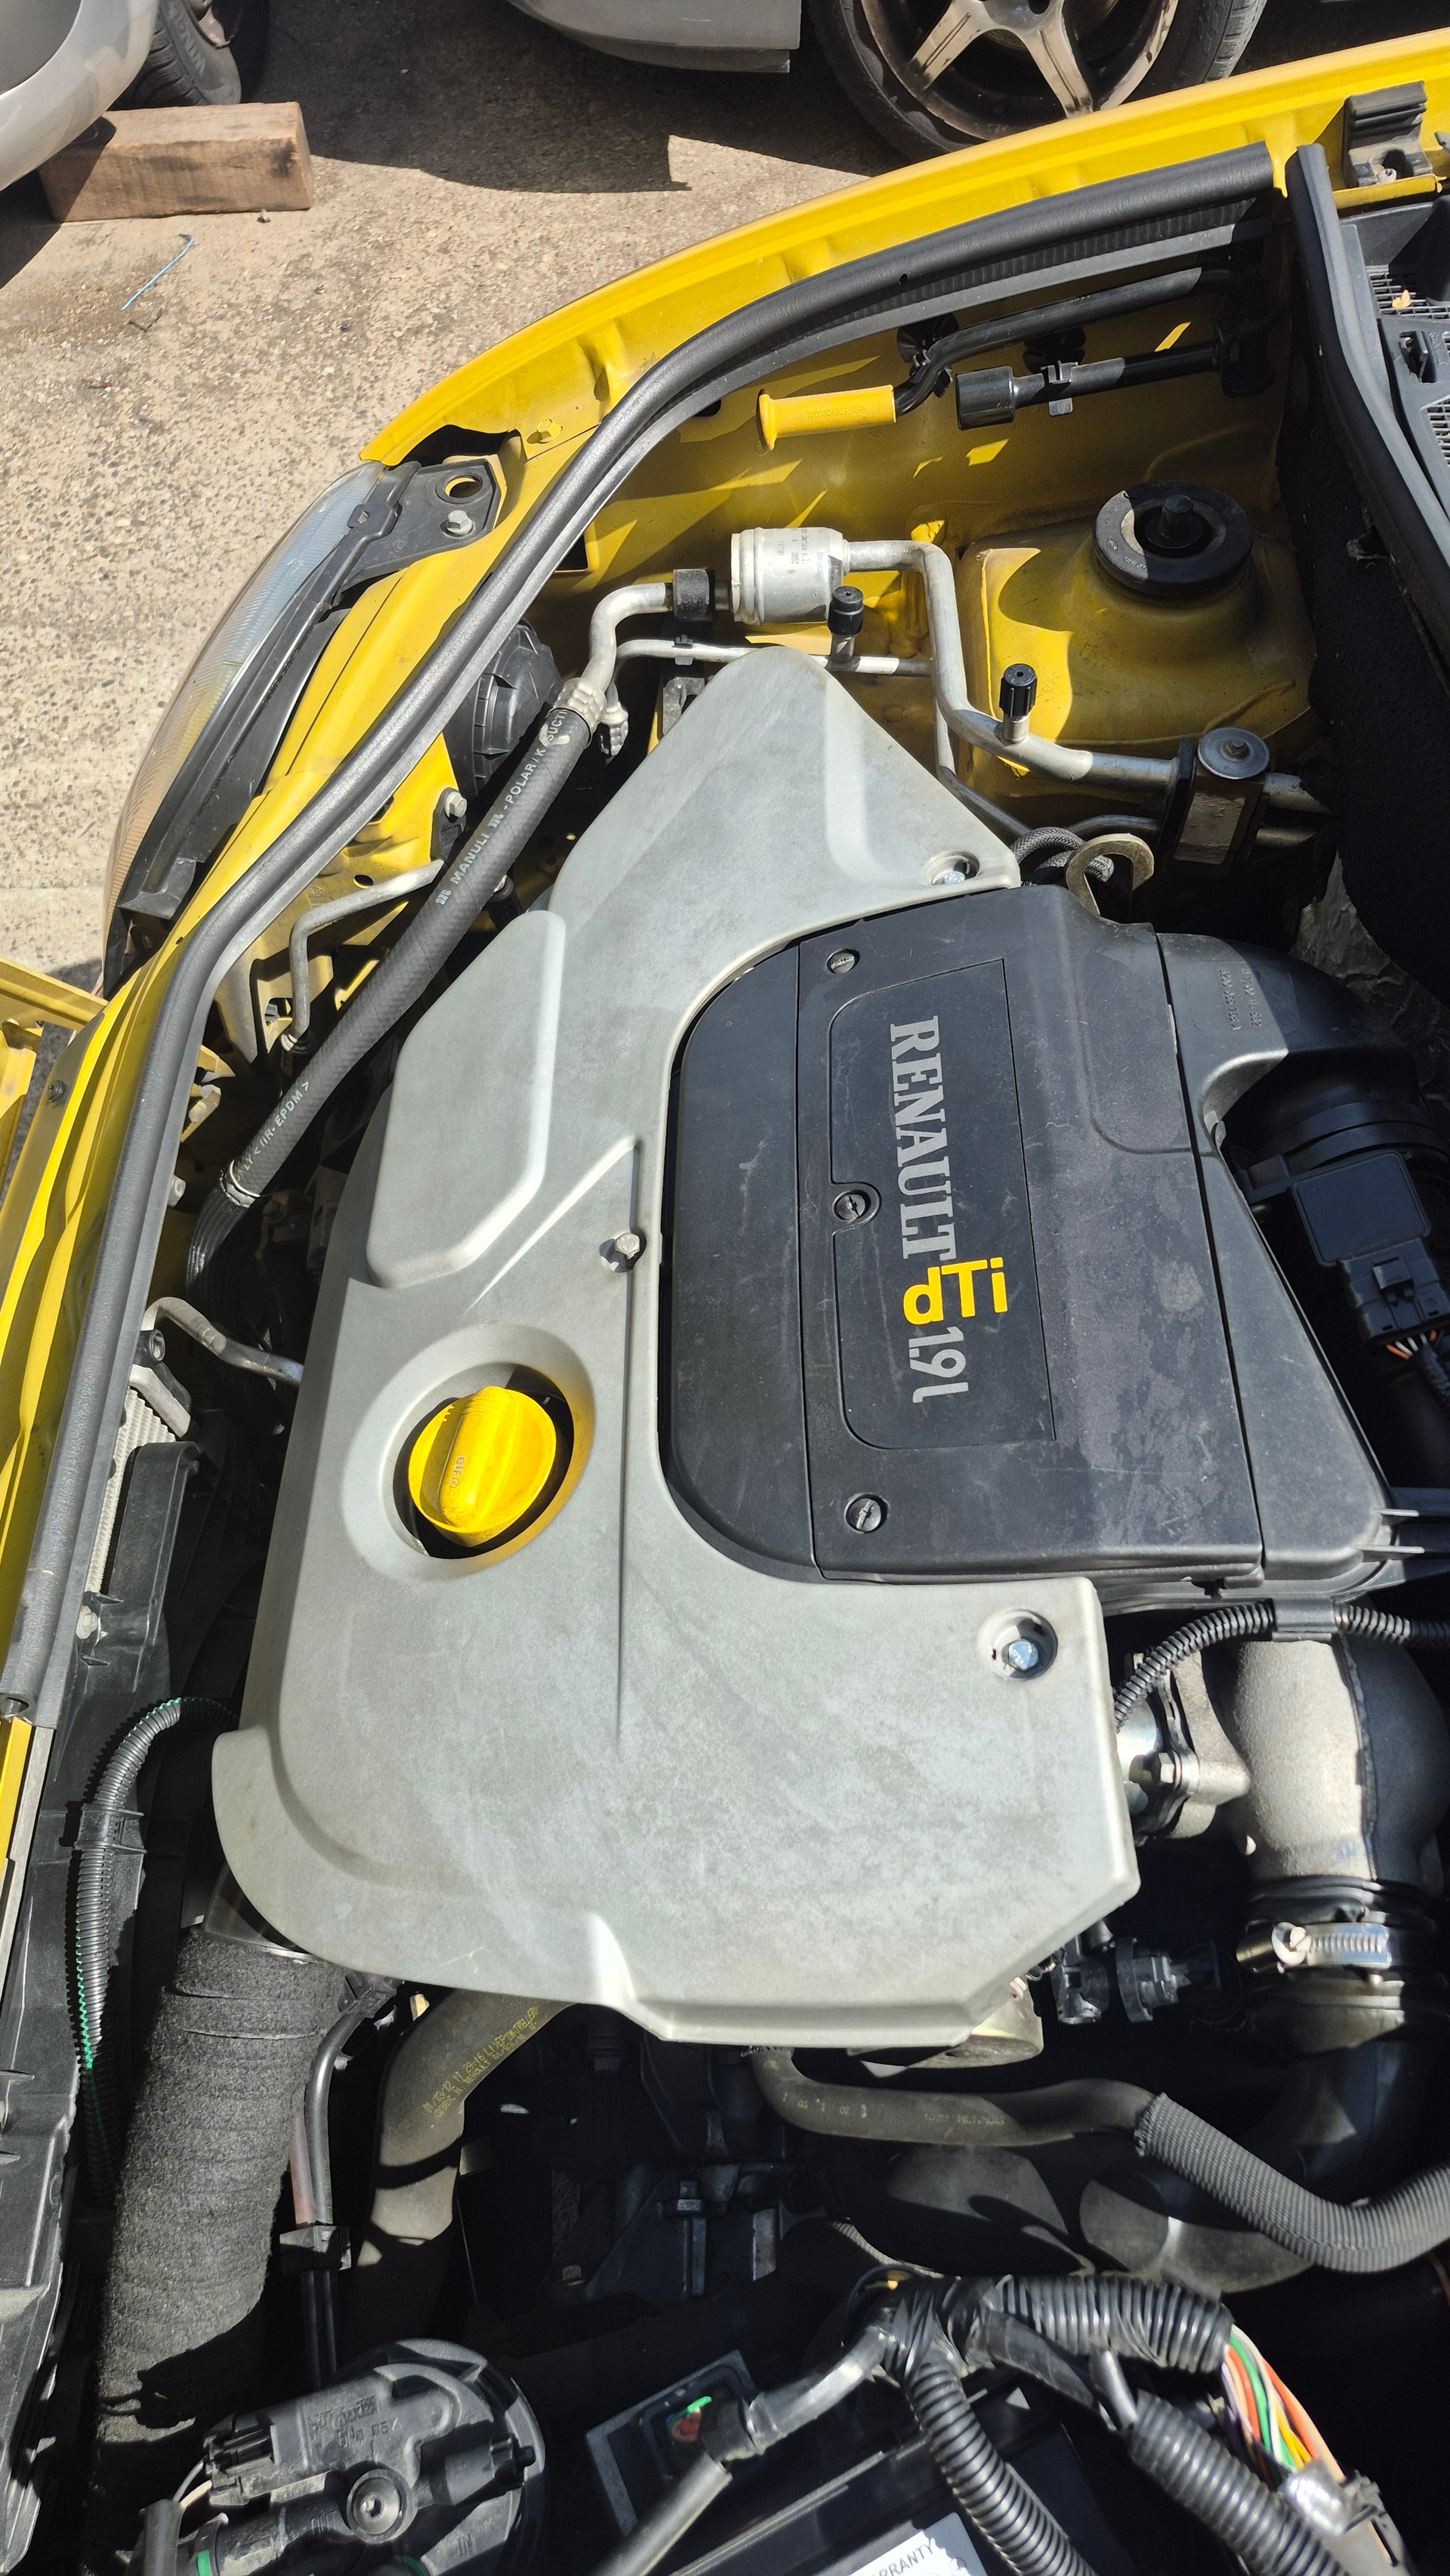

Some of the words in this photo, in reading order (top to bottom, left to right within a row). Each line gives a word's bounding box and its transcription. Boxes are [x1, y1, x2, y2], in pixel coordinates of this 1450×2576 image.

[450, 832, 490, 885] MANULI
[890, 1015, 958, 1261] RENAULT
[902, 1256, 1008, 1325] dTi
[872, 2538, 933, 2576] RRANTY
